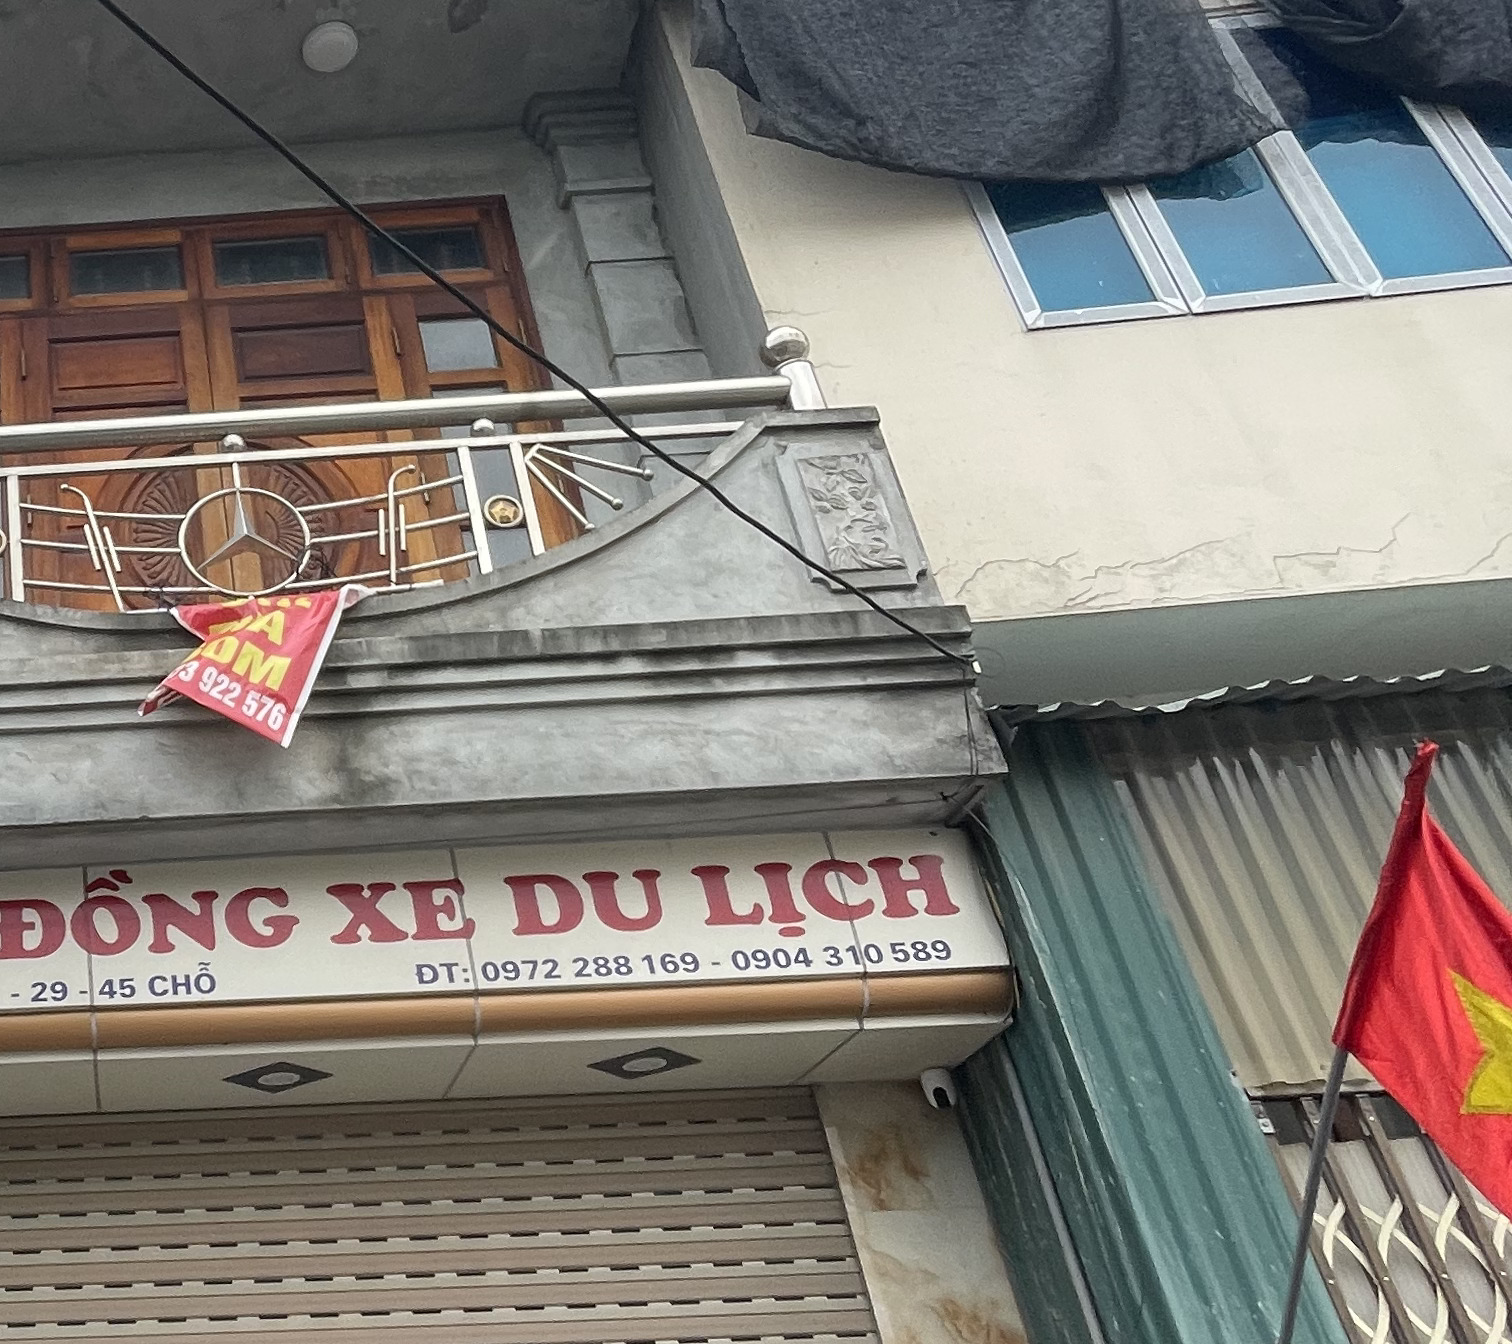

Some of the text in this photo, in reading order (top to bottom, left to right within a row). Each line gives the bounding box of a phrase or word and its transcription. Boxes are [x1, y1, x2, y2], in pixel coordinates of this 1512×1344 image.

[198, 666, 242, 708] 922
[241, 689, 287, 731] 576
[326, 877, 477, 945] XE
[503, 868, 662, 937] DU
[690, 854, 961, 937] LỊCH
[30, 980, 69, 1003] 29
[98, 976, 137, 999] 45
[147, 960, 217, 997] CHỖ
[415, 961, 471, 986] ĐT:
[480, 957, 562, 983] 0972
[573, 954, 634, 979] 288
[641, 950, 701, 976] 169
[730, 946, 814, 972] 0904
[823, 942, 884, 968] 310
[890, 939, 953, 964] 589
